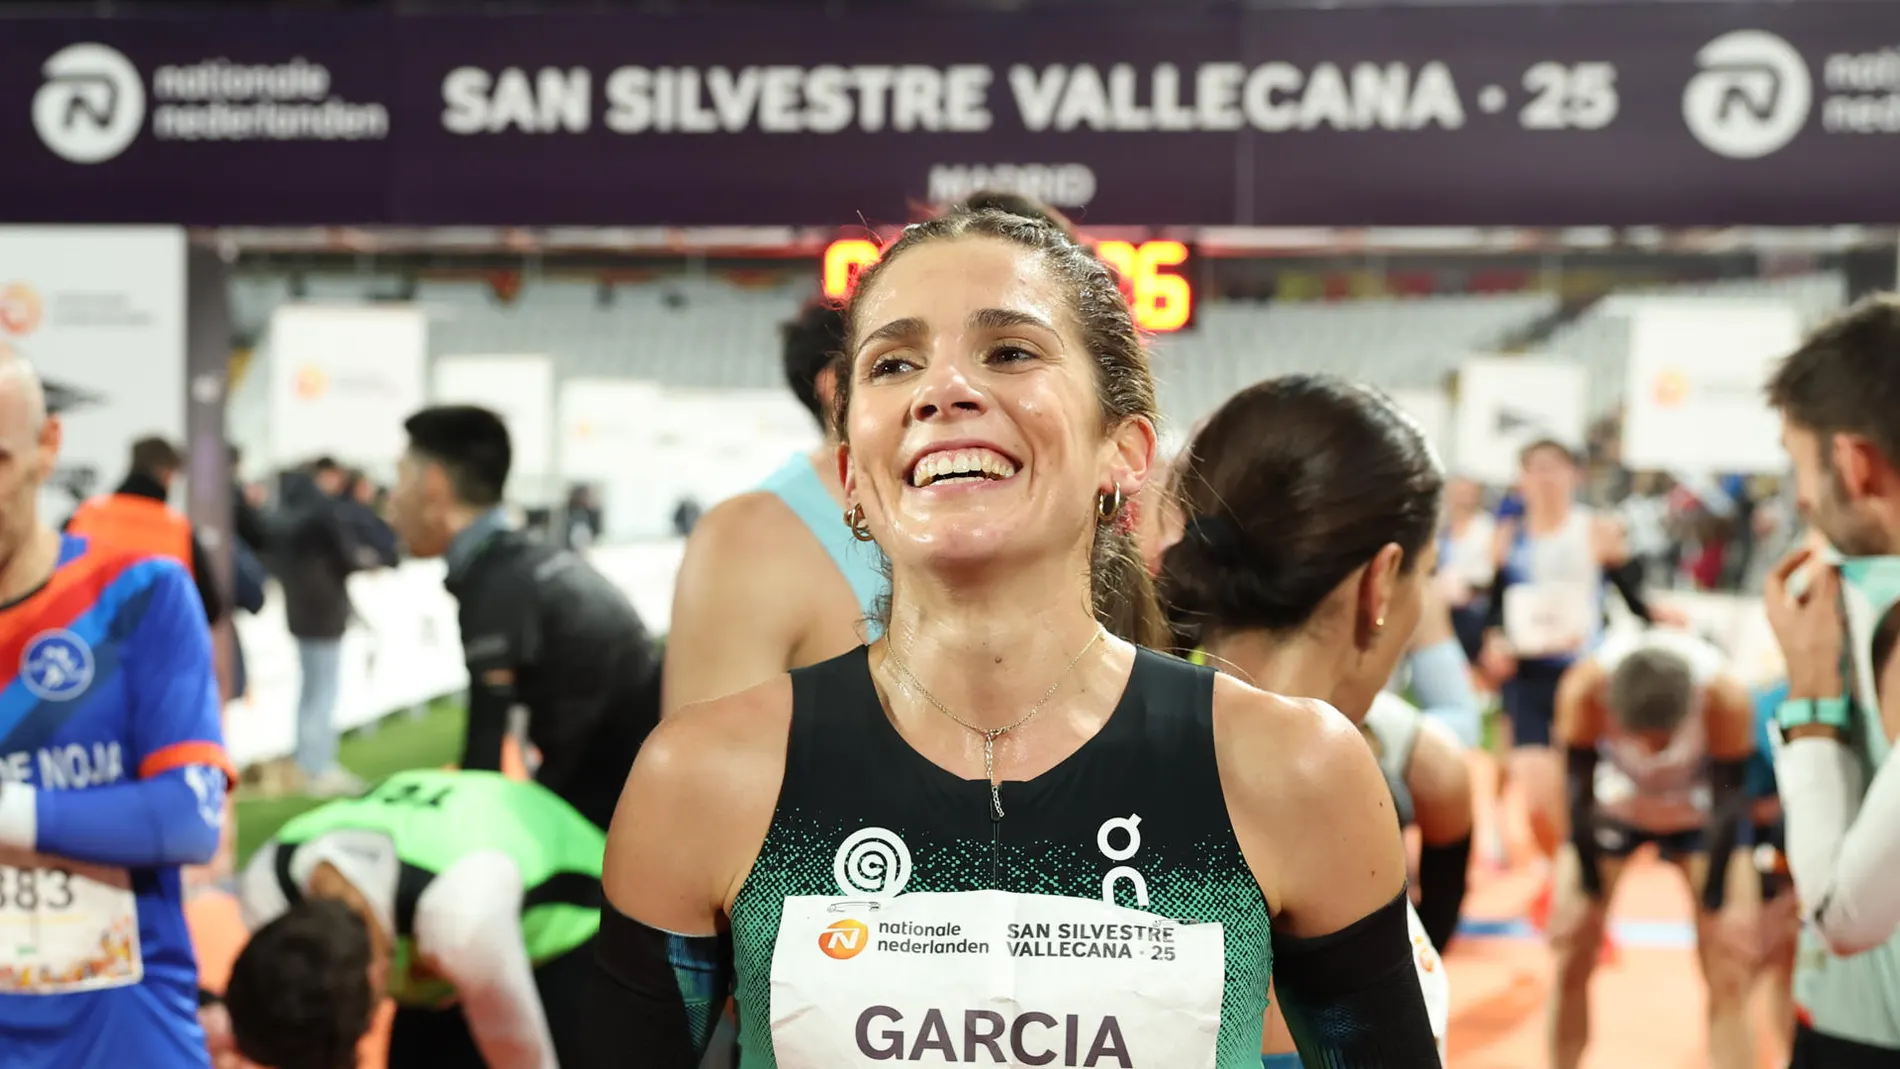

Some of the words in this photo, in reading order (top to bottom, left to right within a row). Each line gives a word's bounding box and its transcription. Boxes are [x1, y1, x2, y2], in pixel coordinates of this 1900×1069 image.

[153, 57, 330, 100] nationale
[442, 67, 591, 134] SAN
[605, 65, 993, 133] SILVESTRE
[1009, 62, 1465, 132] VALLECANA
[1520, 62, 1619, 129] 25
[152, 97, 389, 140] nederlanden
[0, 866, 74, 911] 83
[877, 938, 990, 954] nederlanden
[879, 921, 962, 937] nationale
[1007, 923, 1050, 939] SAN
[1057, 923, 1176, 943] SILVESTRE
[1006, 941, 1133, 959] VALLECANA
[1150, 944, 1177, 962] 25
[855, 1005, 1134, 1069] GARCIA
